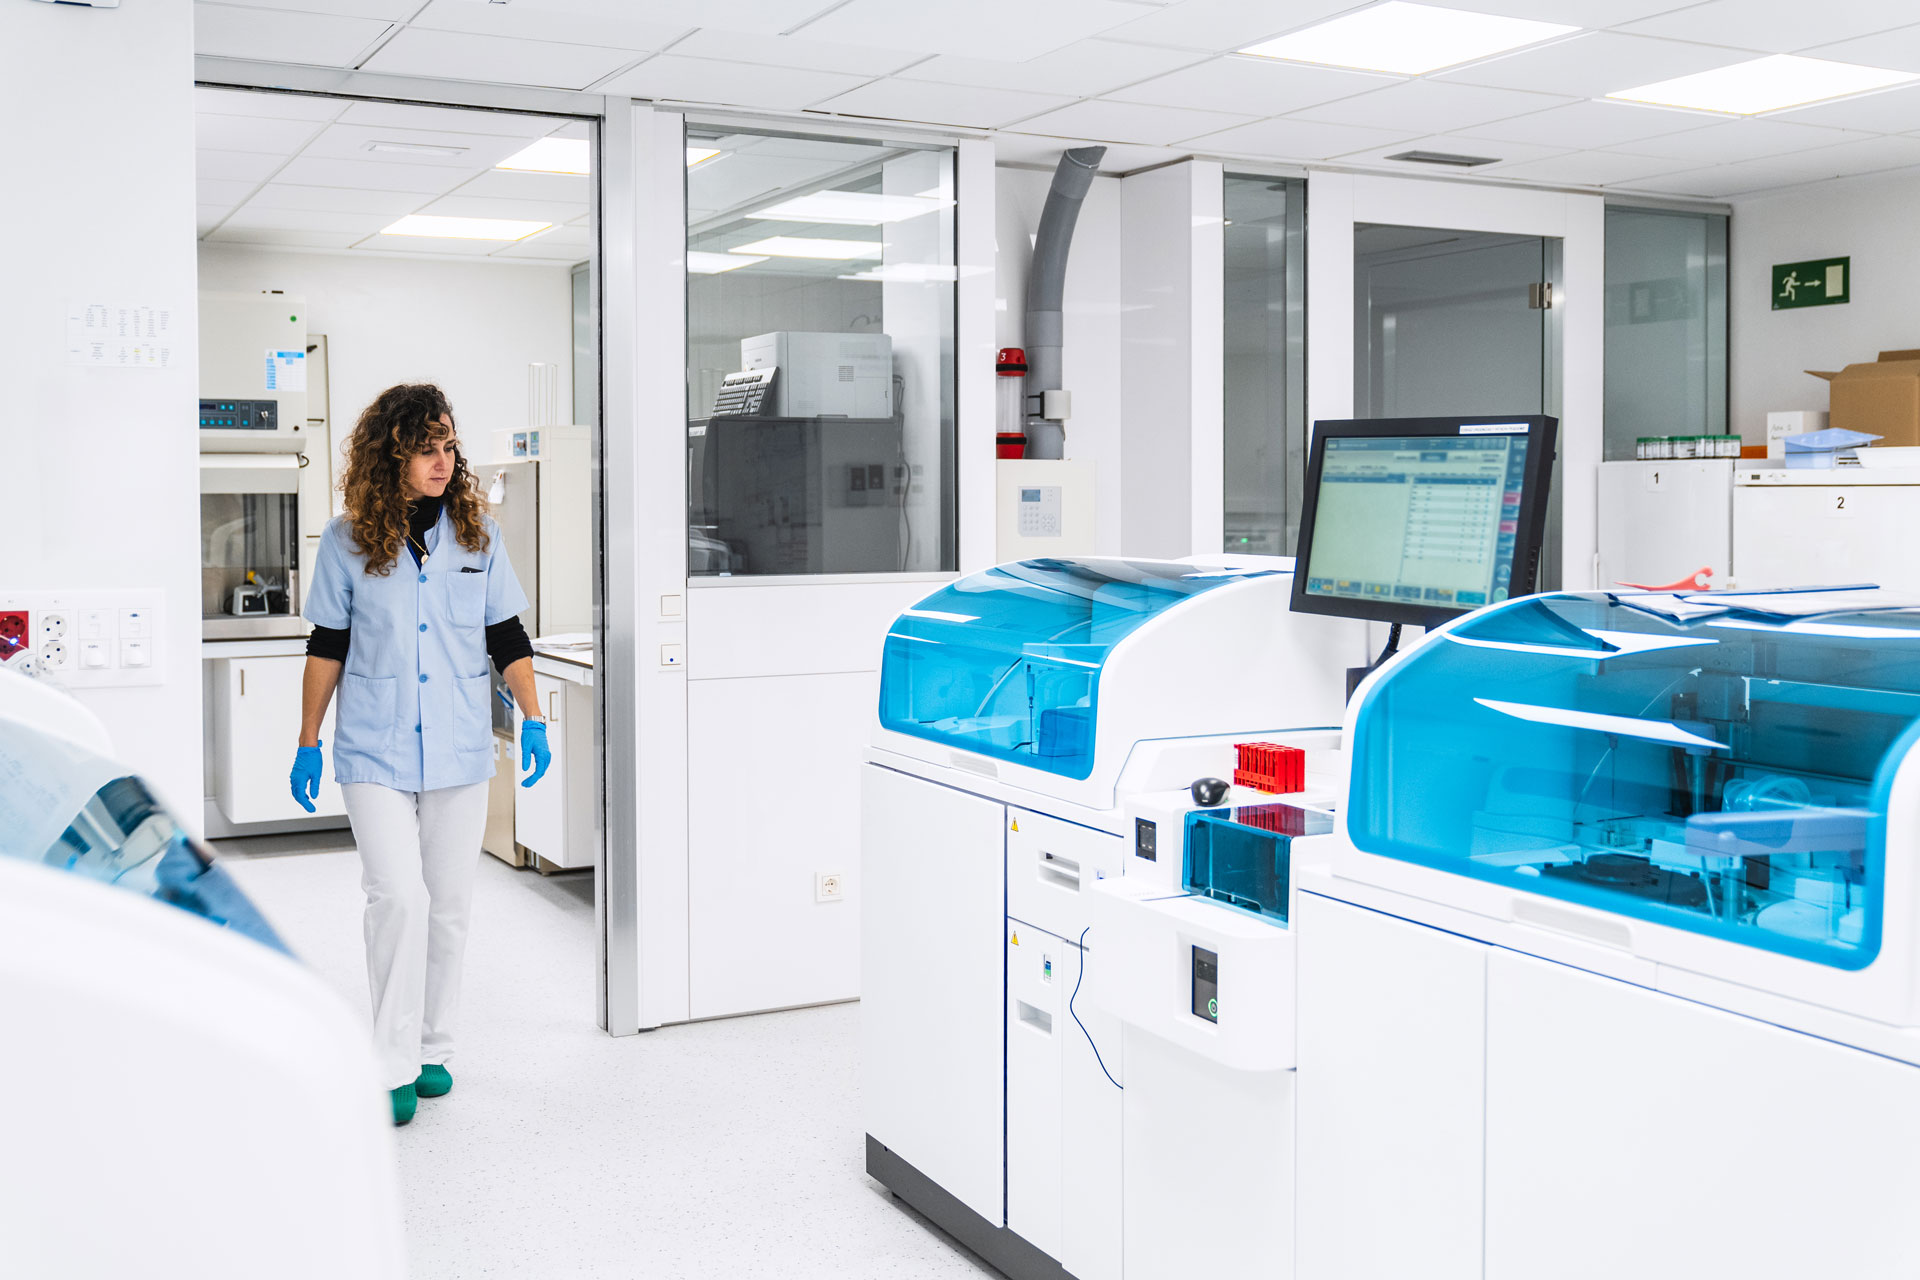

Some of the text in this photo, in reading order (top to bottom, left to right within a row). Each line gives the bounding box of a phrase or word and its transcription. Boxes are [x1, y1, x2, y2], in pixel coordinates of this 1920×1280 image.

[1000, 353, 1006, 362] 3
[1654, 472, 1659, 484] 1
[1837, 496, 1845, 509] 2
